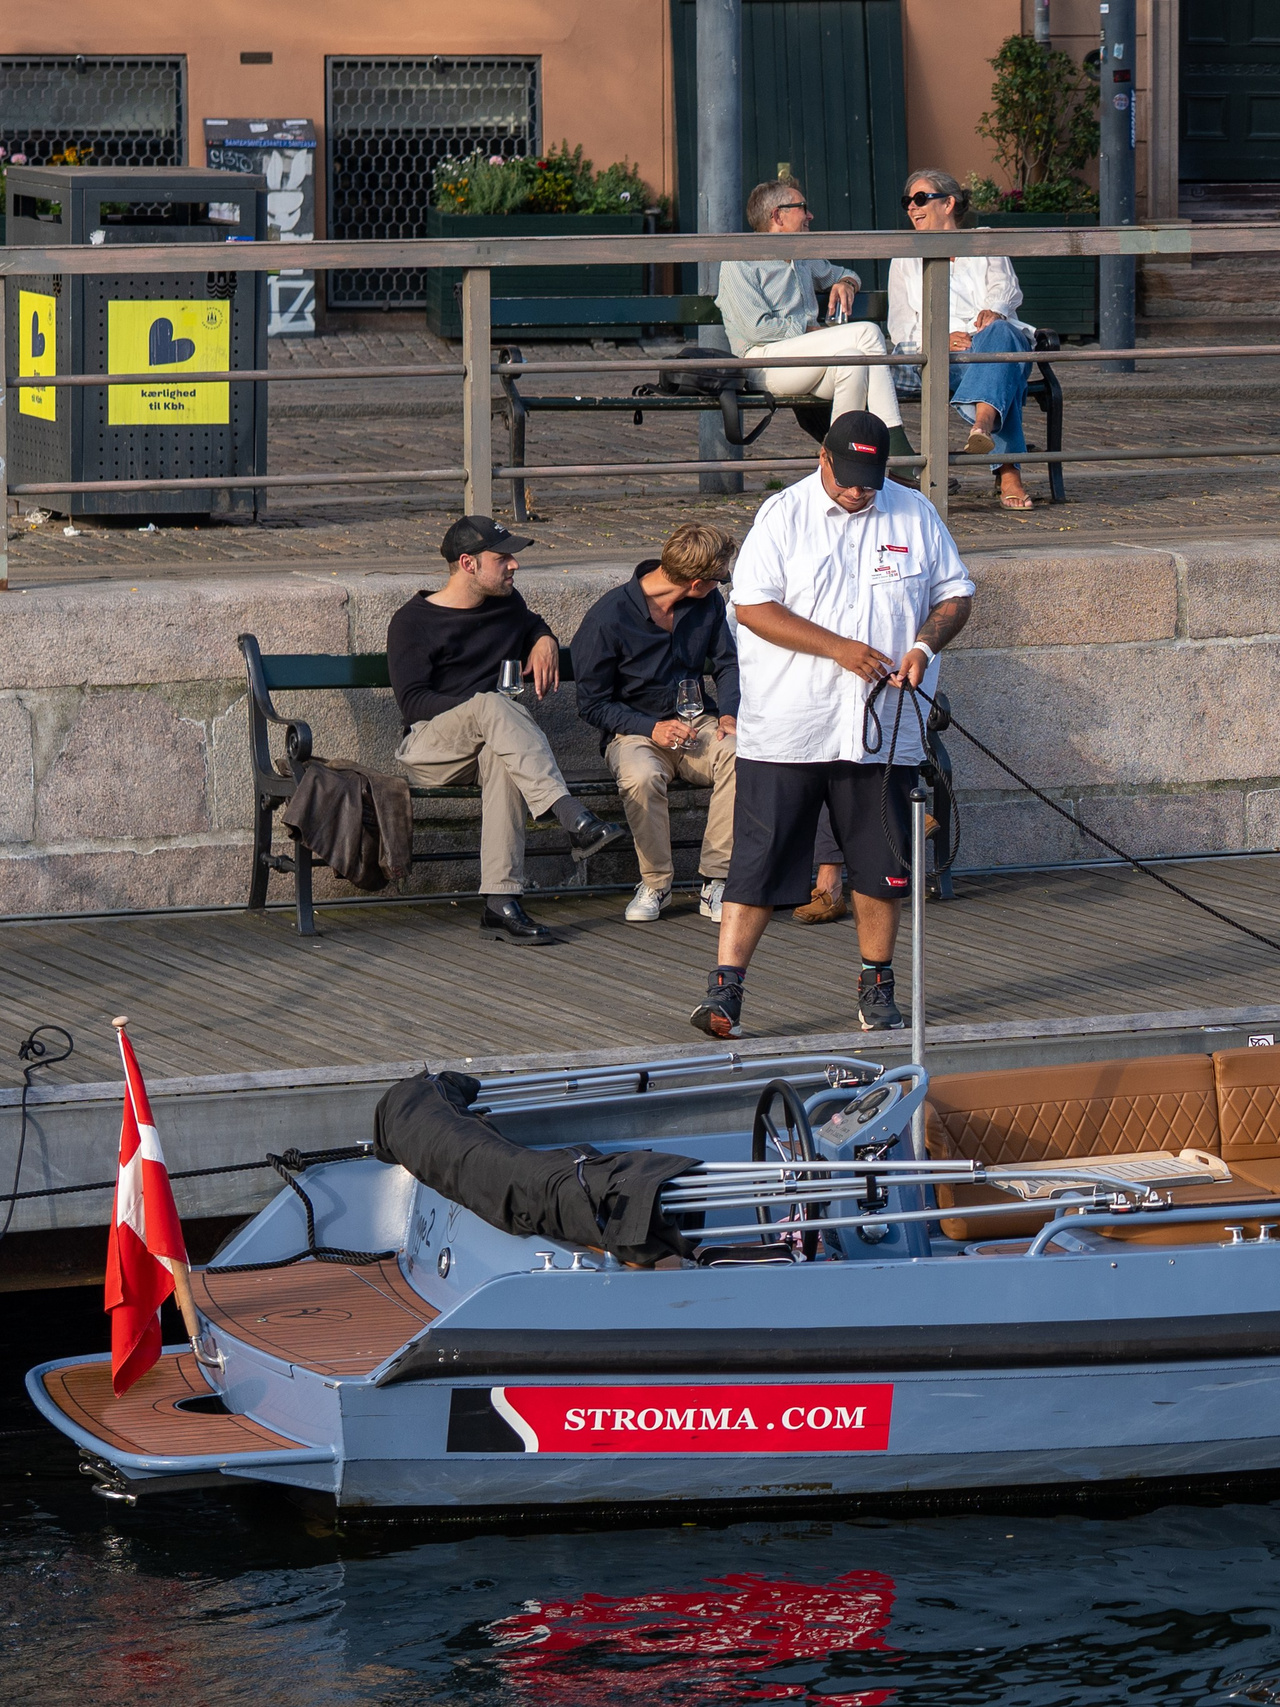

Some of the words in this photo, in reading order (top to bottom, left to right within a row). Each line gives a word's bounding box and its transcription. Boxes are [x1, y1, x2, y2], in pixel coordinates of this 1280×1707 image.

[141, 389, 197, 400] kærlighed
[149, 402, 161, 410] til
[164, 402, 185, 411] Kbh
